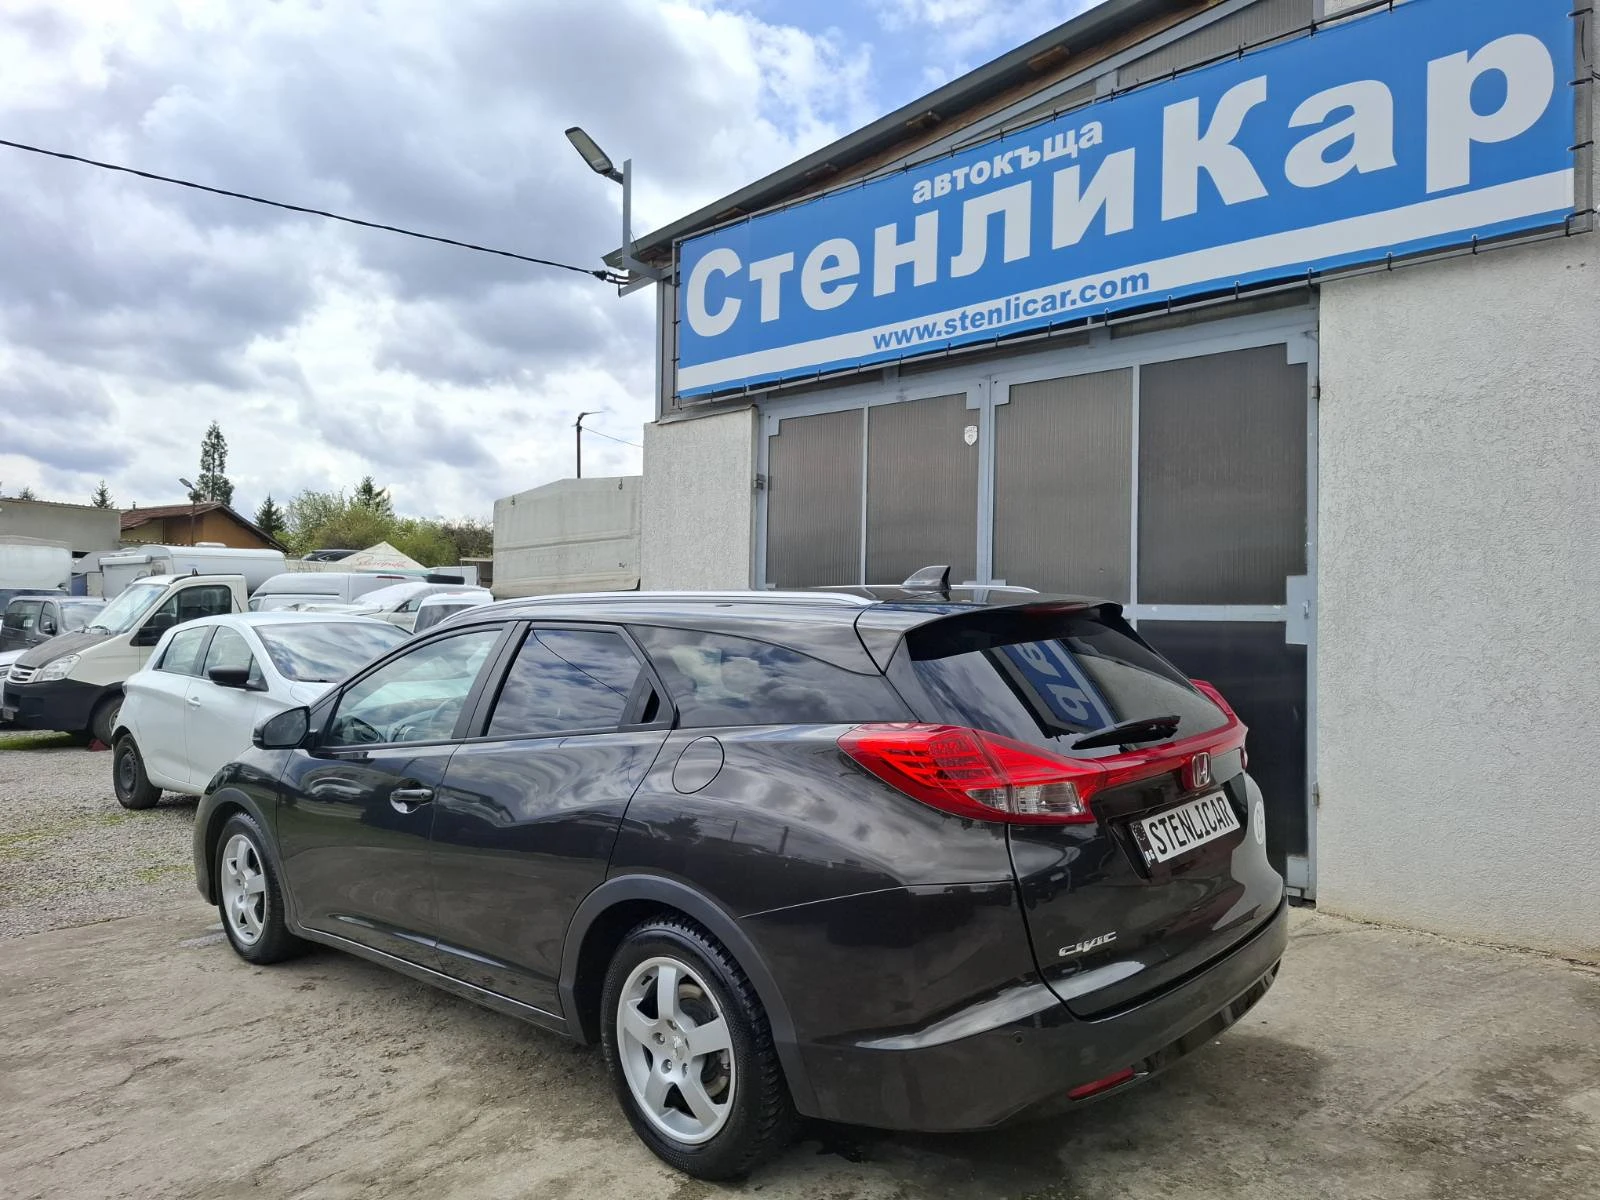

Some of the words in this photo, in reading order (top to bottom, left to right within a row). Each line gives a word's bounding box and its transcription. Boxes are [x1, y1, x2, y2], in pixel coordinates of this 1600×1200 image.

[686, 34, 1555, 337] СтенлиКар
[912, 120, 1103, 204] автокъща
[872, 272, 1150, 350] www.stenlicar.com
[1148, 796, 1235, 855] STENLICAR
